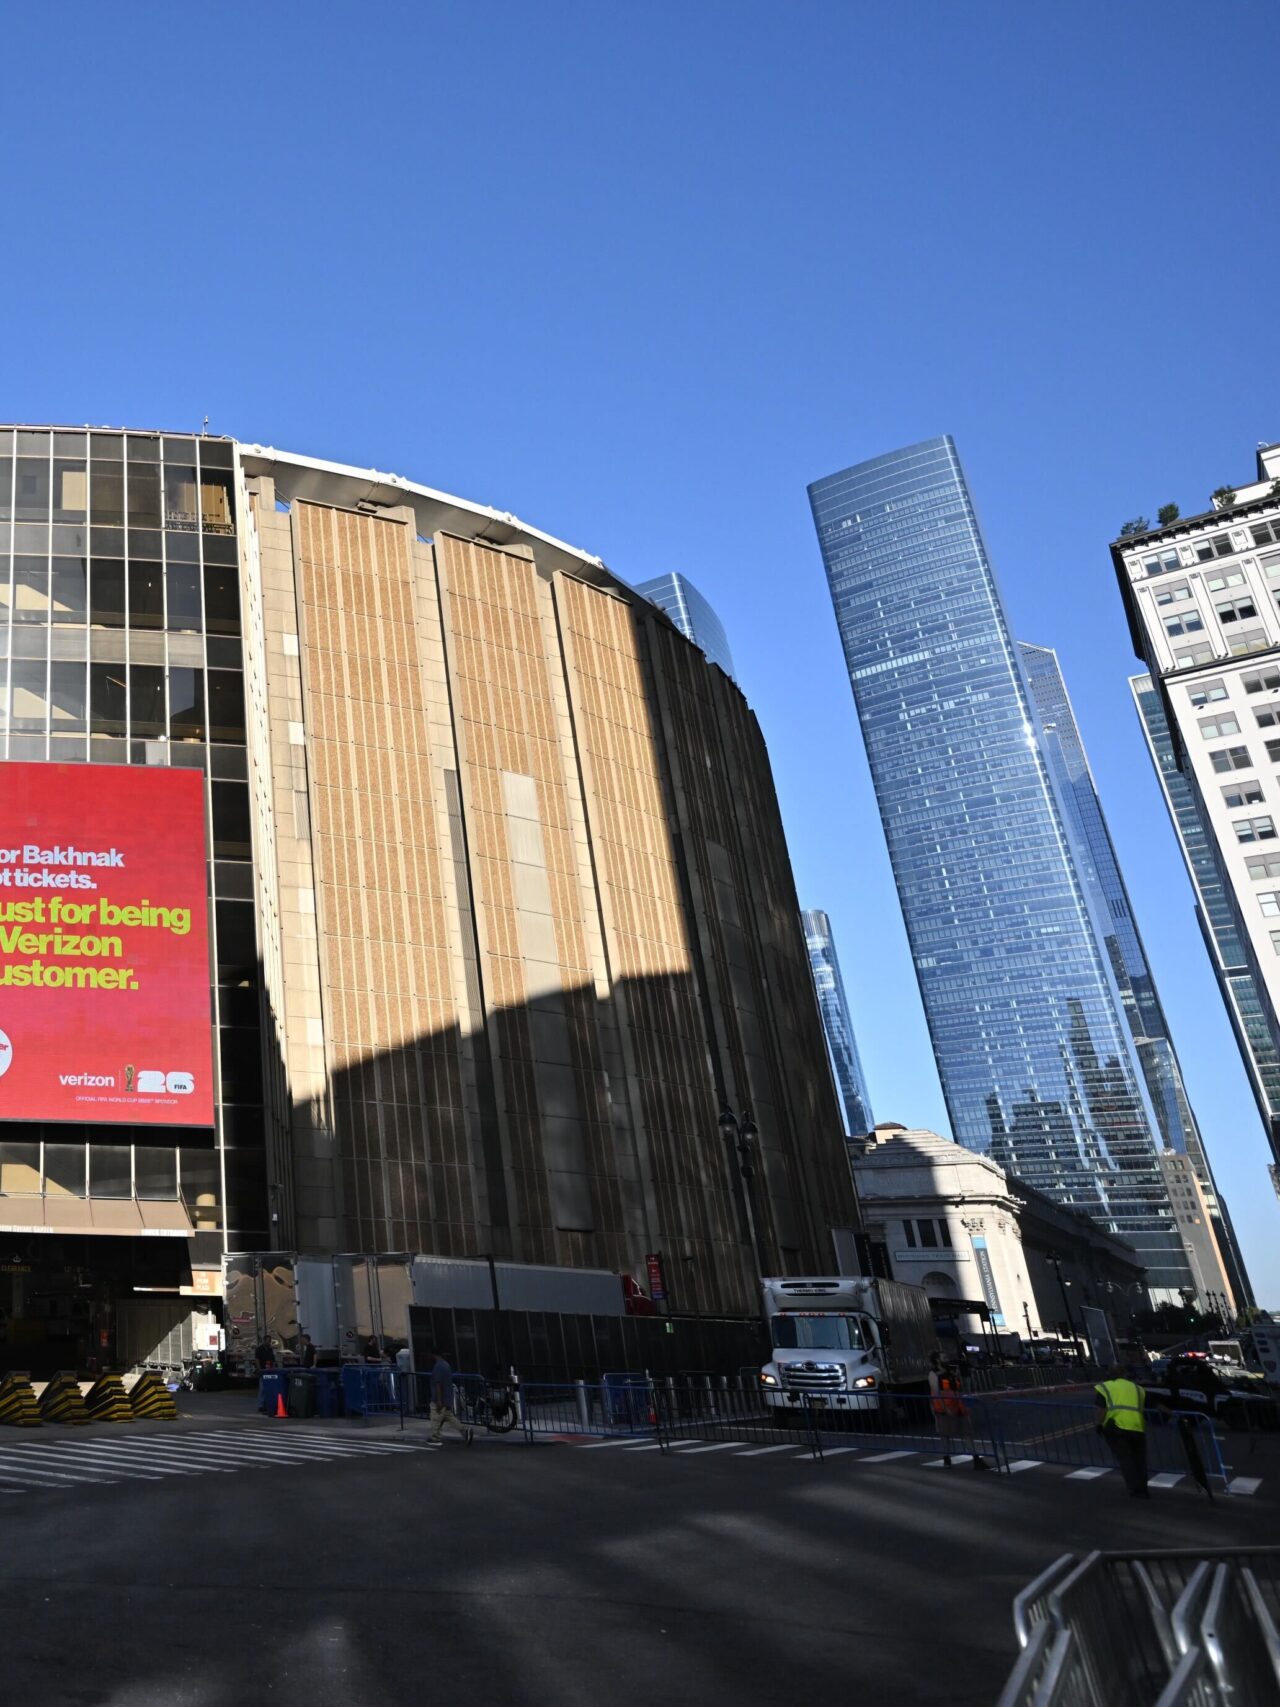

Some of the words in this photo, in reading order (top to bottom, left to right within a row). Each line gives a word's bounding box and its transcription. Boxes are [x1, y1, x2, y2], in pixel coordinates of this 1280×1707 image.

[23, 845, 125, 867] Bakhnak
[14, 868, 97, 889] tickets.
[48, 896, 96, 925] for
[99, 898, 191, 935] being
[59, 1072, 115, 1088] verizon
[137, 1070, 195, 1094] 26
